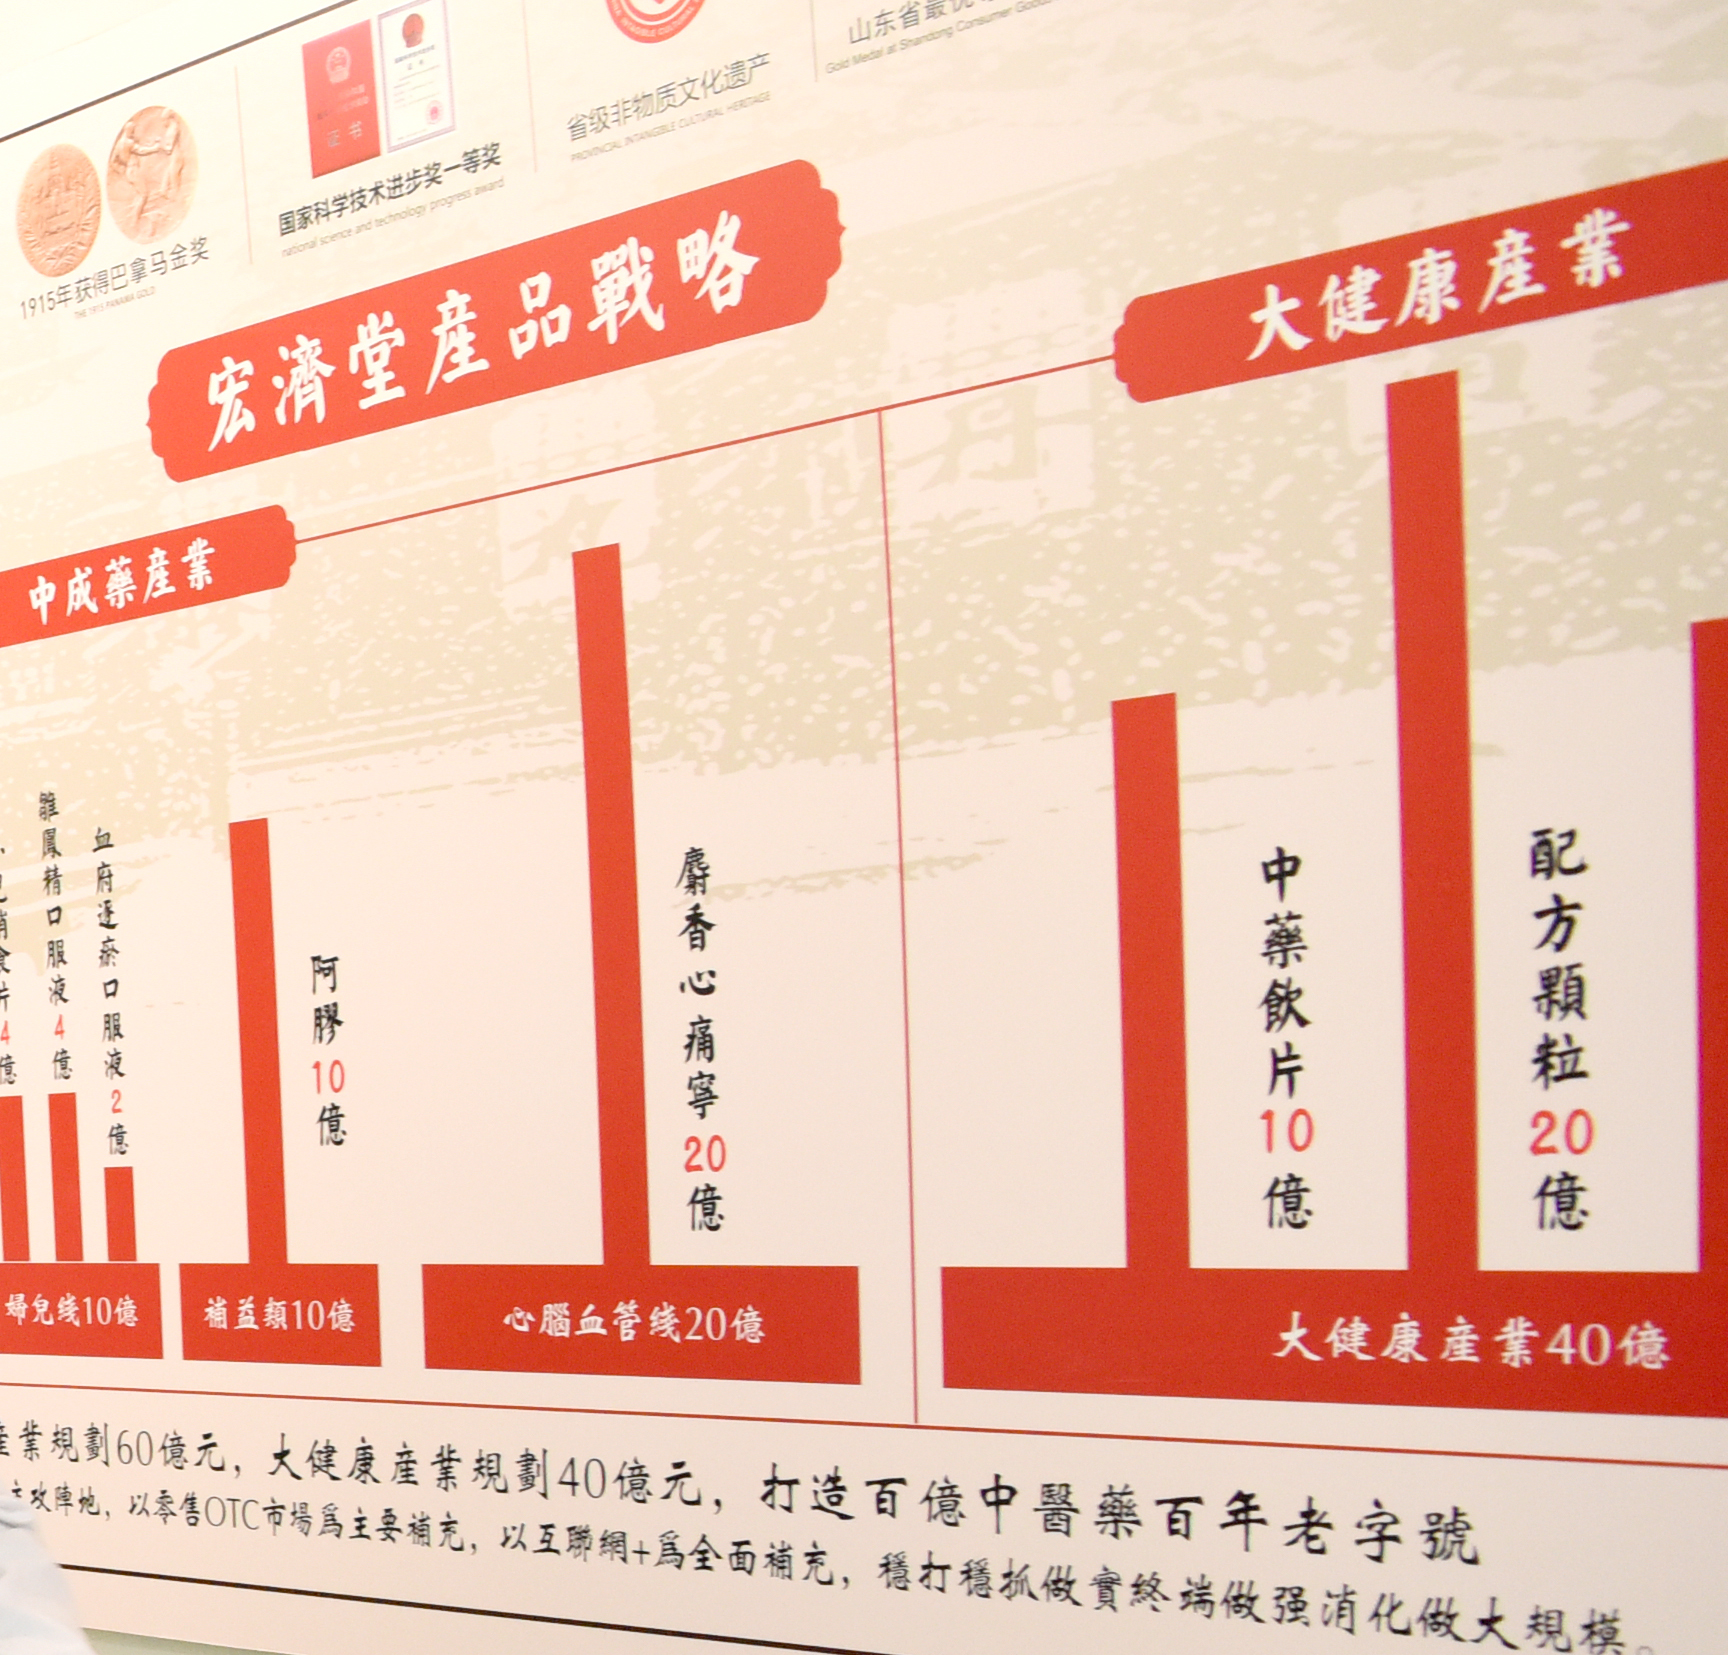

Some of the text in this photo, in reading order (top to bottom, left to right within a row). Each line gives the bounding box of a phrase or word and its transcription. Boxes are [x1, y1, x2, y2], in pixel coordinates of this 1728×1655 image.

[566, 52, 771, 142] 省级非物质文化遗产
[278, 141, 501, 237] 国家科学技术进步奖一等奖
[319, 227, 352, 246] science
[355, 218, 373, 235] and
[374, 202, 427, 228] technology
[429, 189, 472, 212] progress
[474, 176, 505, 196] award
[19, 235, 210, 320] 1915年获得巴拿马金奖
